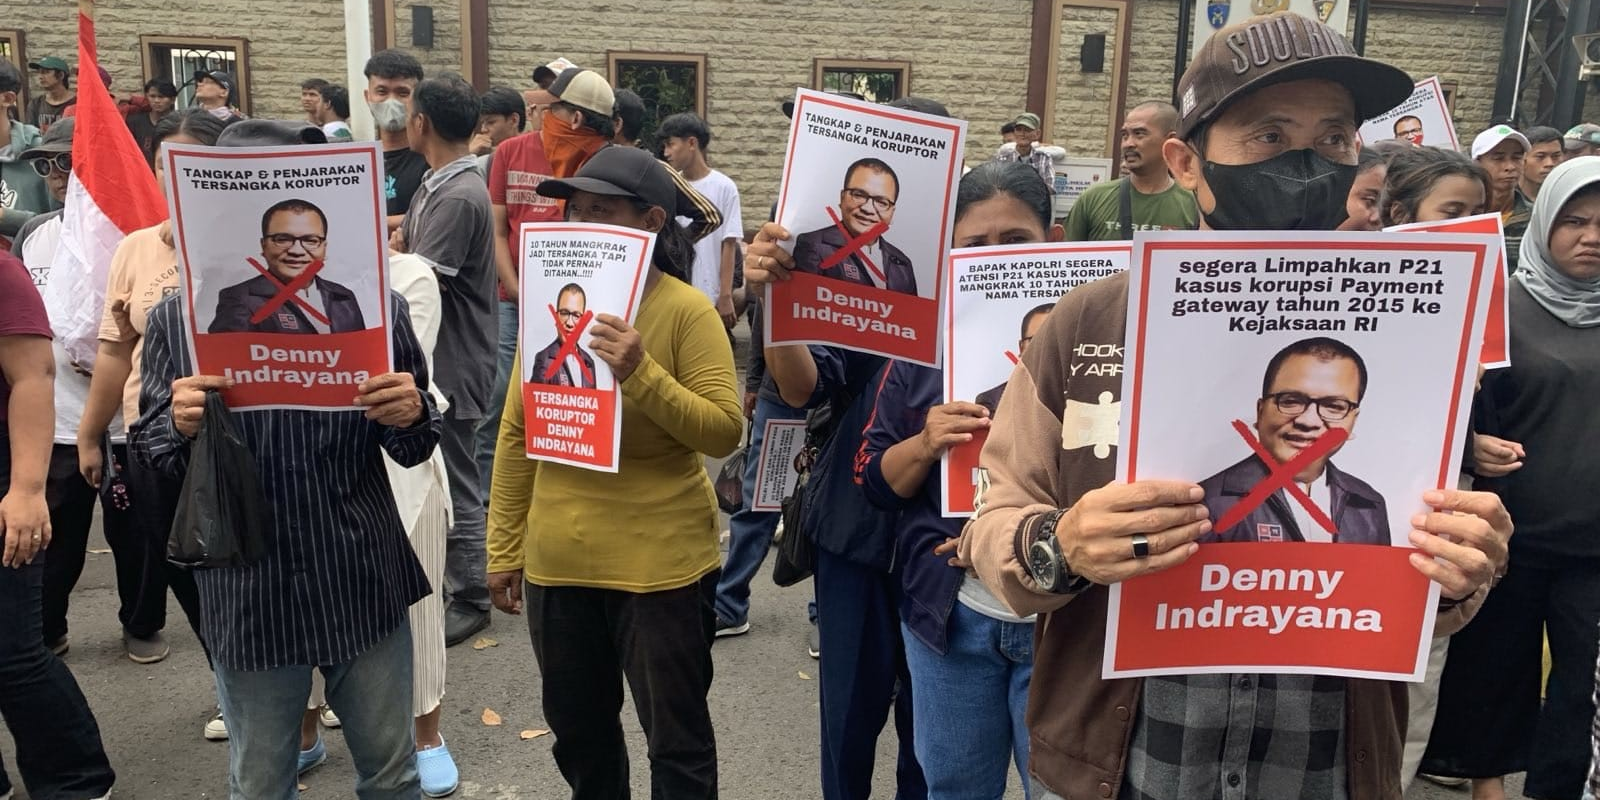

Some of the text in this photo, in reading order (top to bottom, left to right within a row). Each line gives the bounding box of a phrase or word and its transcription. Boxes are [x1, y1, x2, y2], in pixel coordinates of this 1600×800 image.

[805, 112, 946, 150] TANGKAP & PENJARAKAN
[808, 124, 938, 160] TERSANGKA KORUPTOR
[183, 164, 366, 180] TANGKAP & PENJARAKAN
[192, 175, 360, 190] TERSANGKA KORUPTOR
[529, 250, 626, 262] JADI TERSANGKA TAPI
[531, 240, 628, 253] 10 TAHUN MANGKRAK
[542, 260, 603, 269] TIDAK PERNAH
[969, 259, 1113, 273] BAPAK KAPOLRI SEGERA
[1179, 257, 1444, 278] segera Limpahkan P21
[959, 272, 999, 283] ATENSI
[1002, 271, 1024, 281] P21
[1026, 270, 1067, 280] KASUS
[960, 280, 1025, 292] MANGKRAK
[1029, 280, 1042, 289] 10
[1046, 279, 1088, 289] TAHUN
[985, 288, 1070, 300] NAMA TERSAN
[1174, 277, 1444, 297] kasus korupsi Payment
[816, 286, 894, 319] Denny
[1172, 296, 1441, 317] gateway tahun 2015 ke
[792, 302, 918, 340] Indrayana
[1228, 316, 1379, 335] Kejaksaan RI
[250, 344, 342, 368] Denny
[224, 365, 370, 388] Indrayana
[532, 391, 599, 410] TERSANGKA
[536, 406, 596, 426] KORUPTOR
[548, 422, 584, 440] DENNY
[532, 436, 595, 458] INDRAYANA
[1200, 564, 1344, 600] Denny
[1155, 599, 1383, 634] Indrayana
